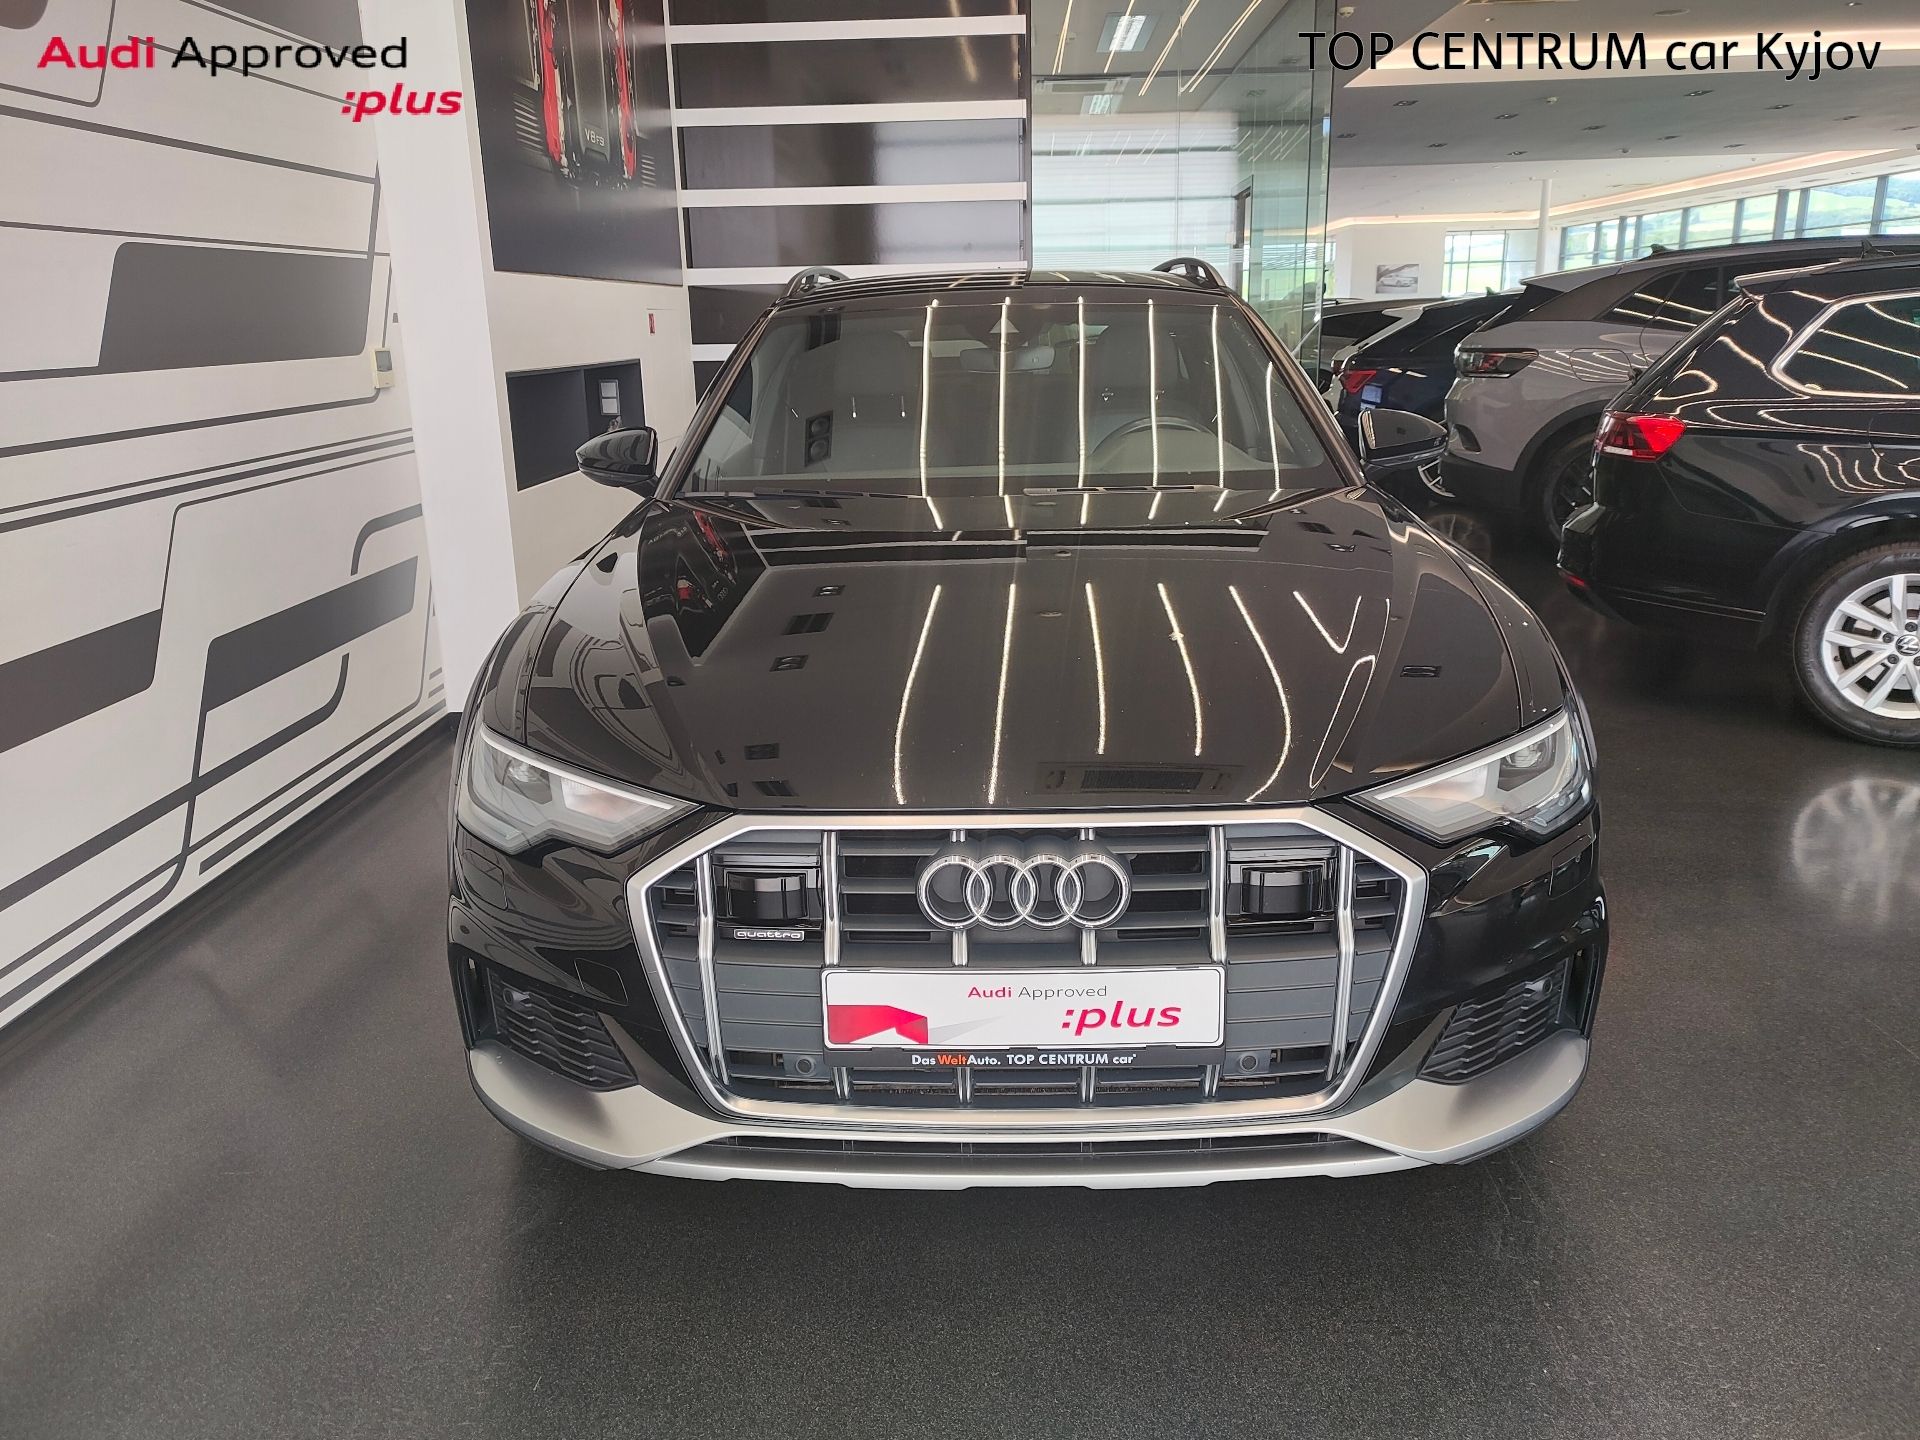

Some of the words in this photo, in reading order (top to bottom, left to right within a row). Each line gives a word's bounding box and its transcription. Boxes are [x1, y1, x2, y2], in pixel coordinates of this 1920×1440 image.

[736, 930, 801, 940] quattro
[967, 986, 1012, 998] Audi
[1017, 985, 1107, 1001] Approved
[1061, 1000, 1182, 1036] :plus
[911, 1054, 936, 1066] Das
[1006, 1053, 1035, 1065] TOP
[1038, 1053, 1109, 1066] CENTRUM
